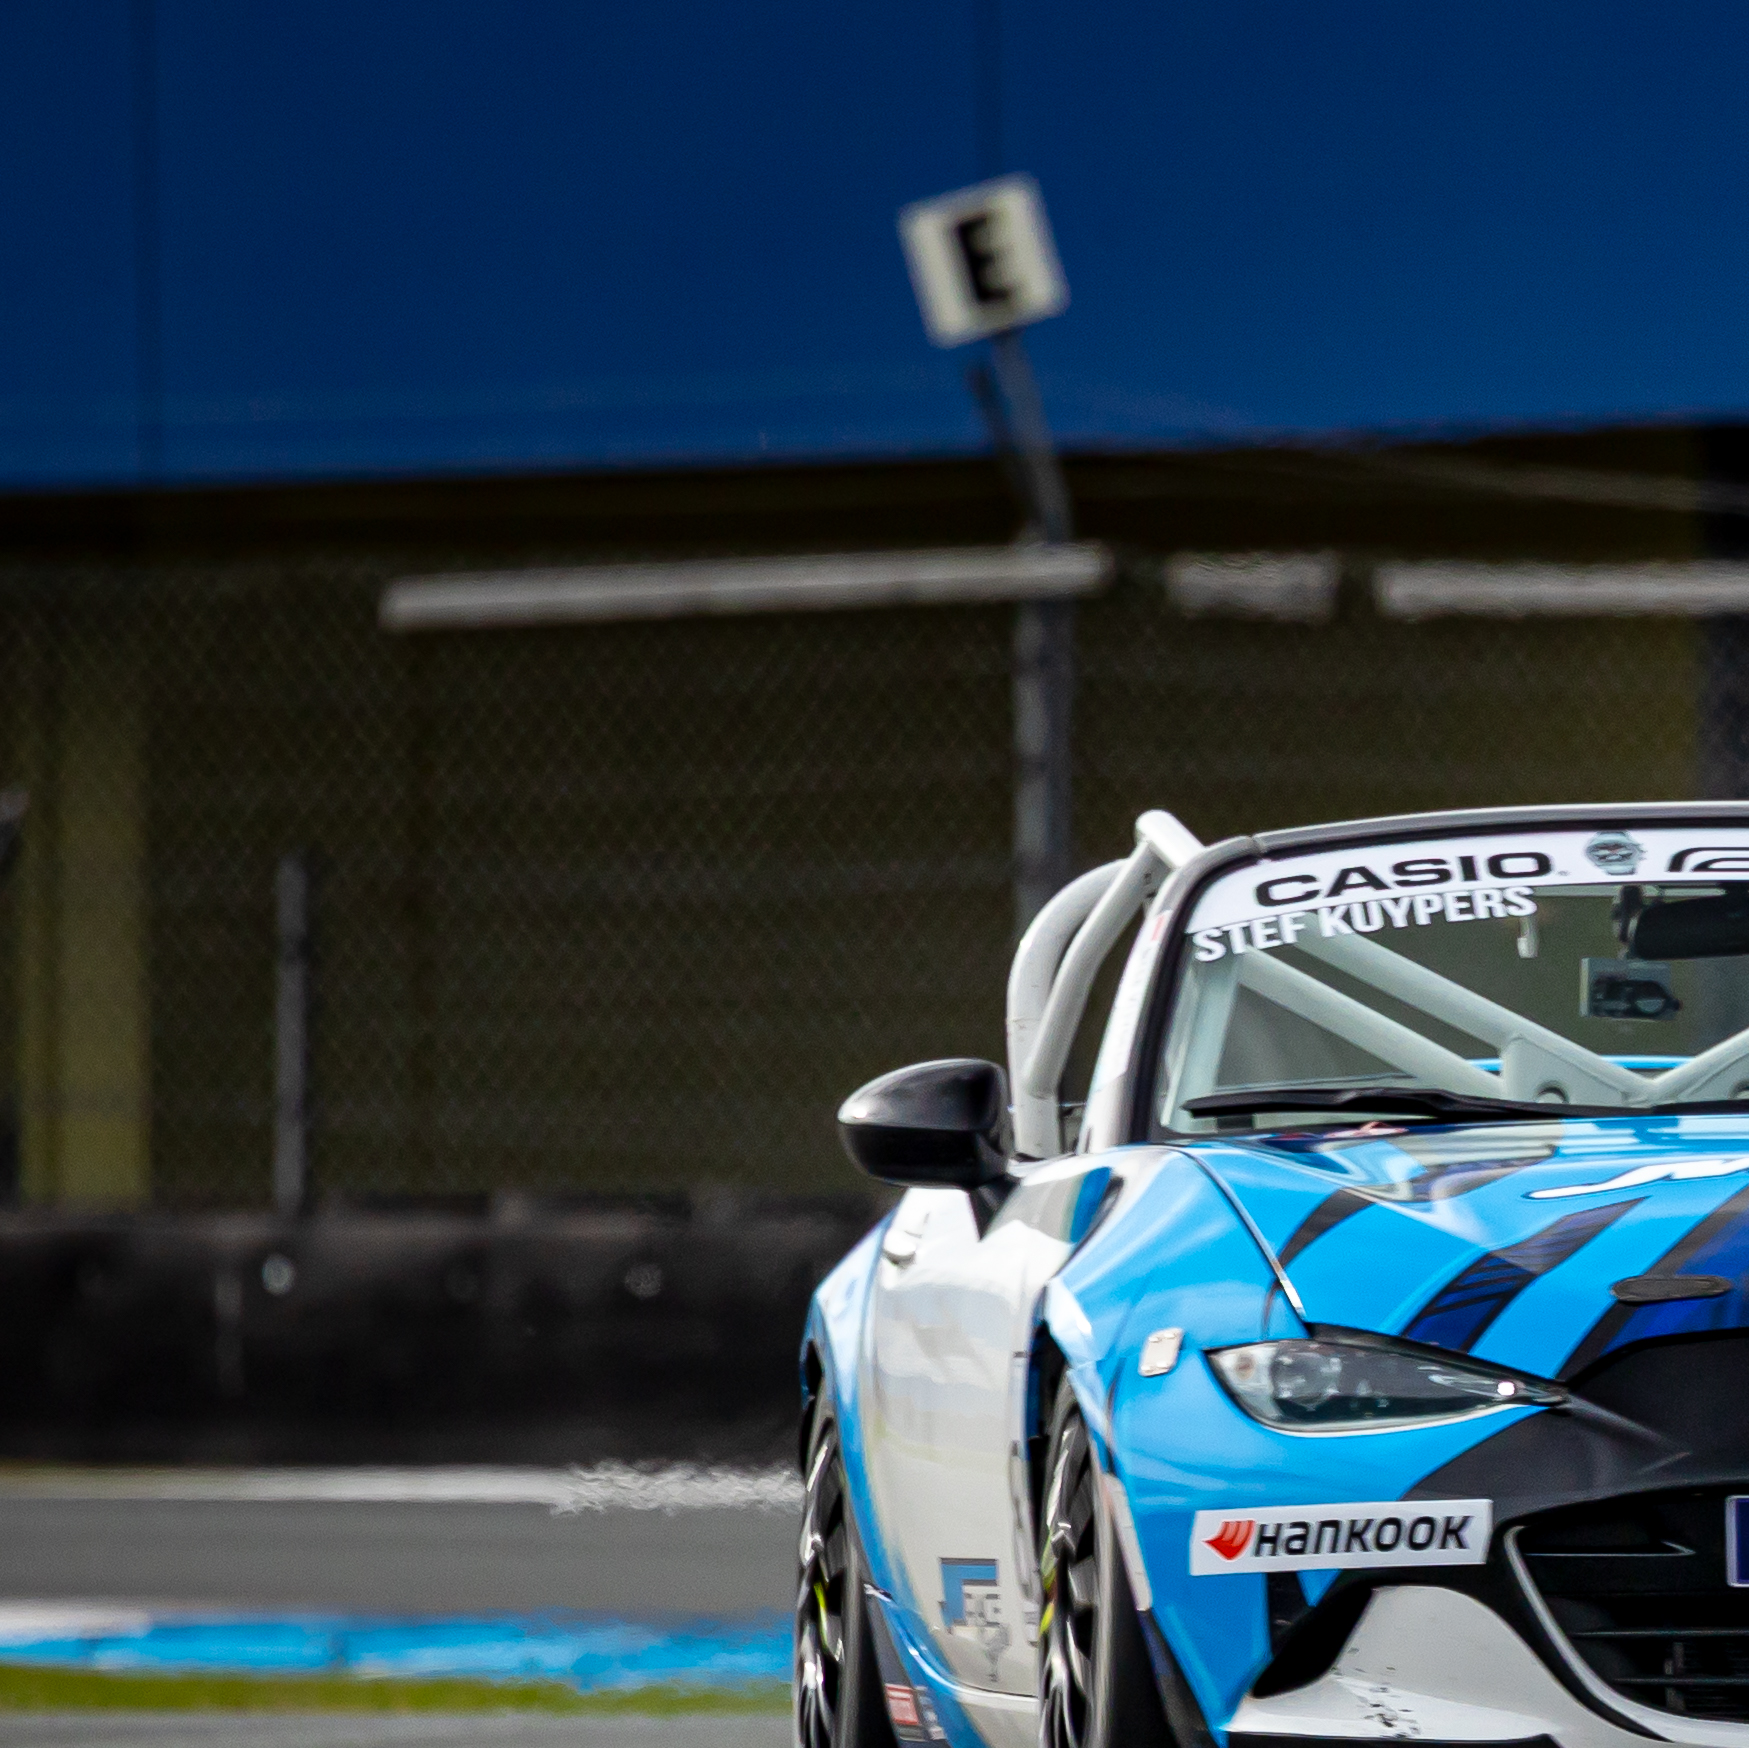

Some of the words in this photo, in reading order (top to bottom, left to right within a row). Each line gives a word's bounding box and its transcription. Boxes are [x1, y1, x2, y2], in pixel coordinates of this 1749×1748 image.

[950, 208, 1018, 306] E
[1255, 851, 1551, 908] CASIO
[1191, 912, 1306, 962] STEF
[1319, 886, 1537, 938] KUYPERS
